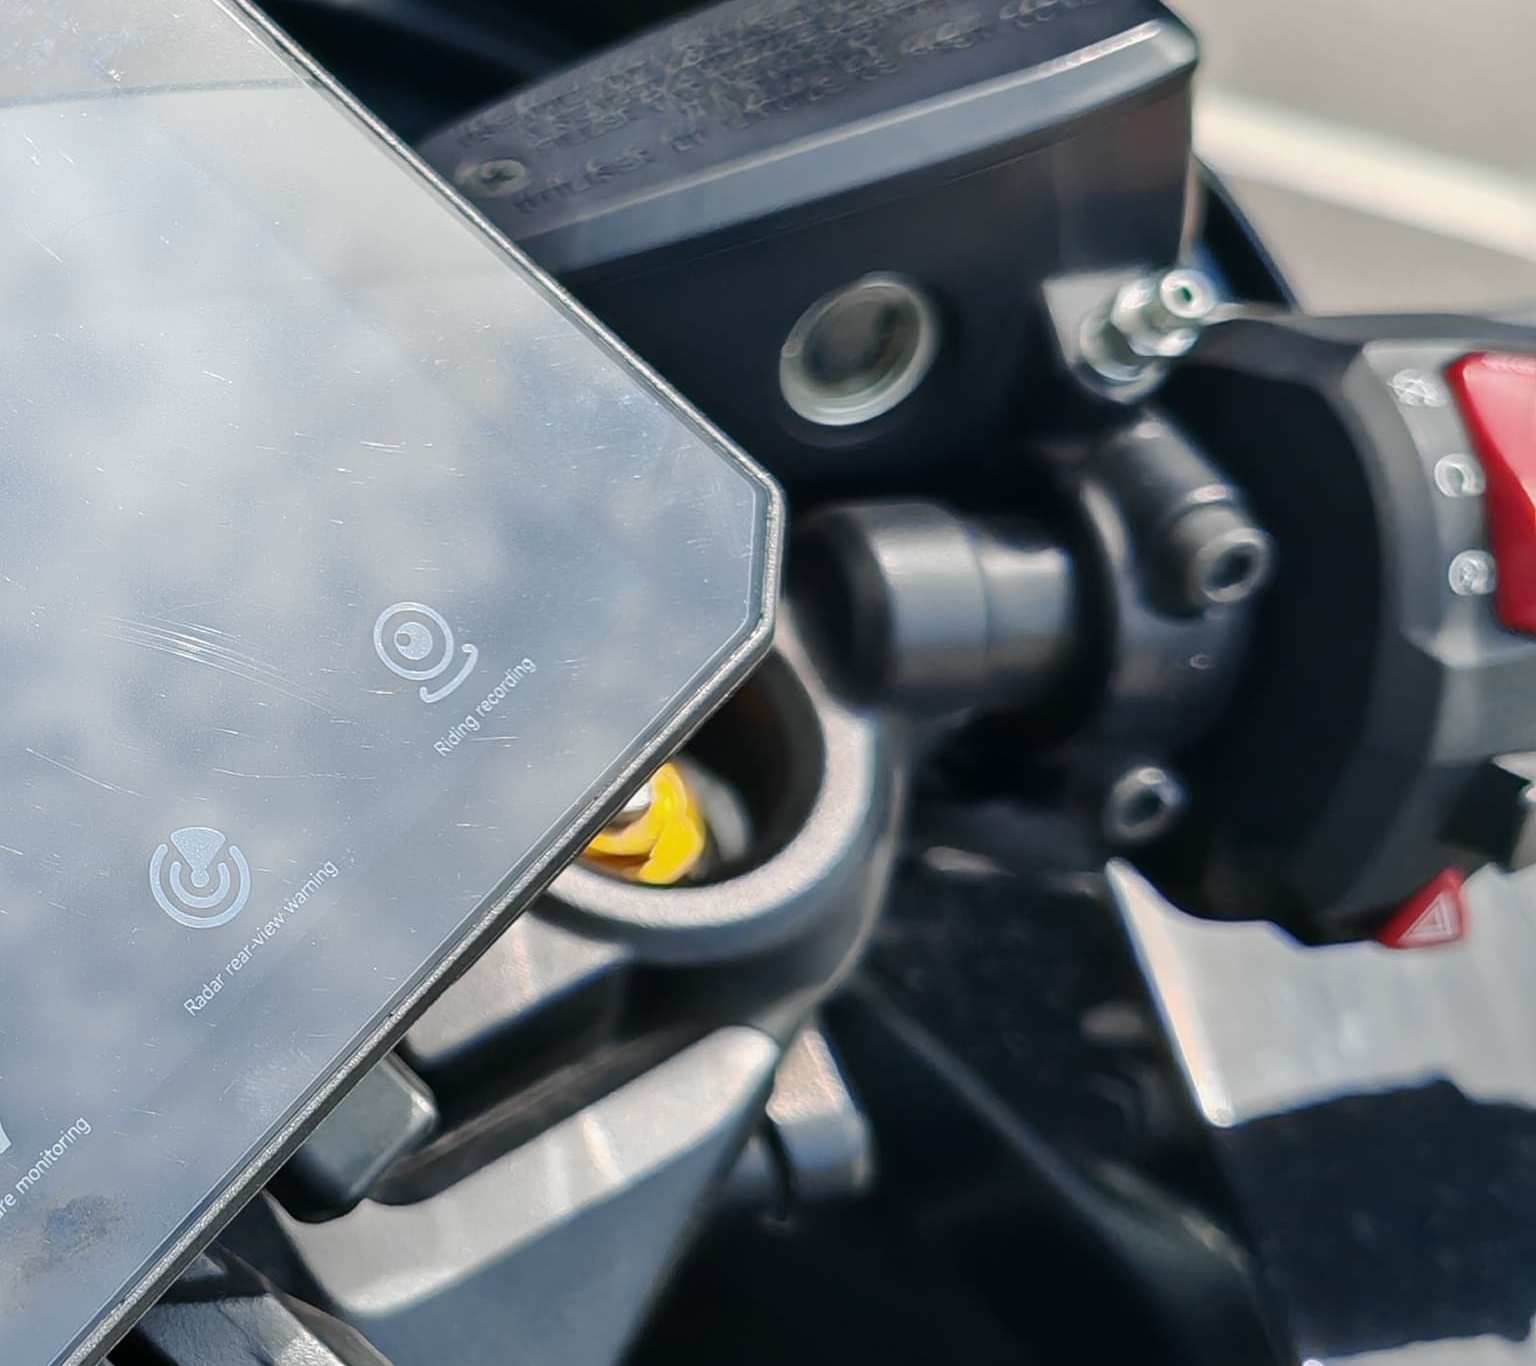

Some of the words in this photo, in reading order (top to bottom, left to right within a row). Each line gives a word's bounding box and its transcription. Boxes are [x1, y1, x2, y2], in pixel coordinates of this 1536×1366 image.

[433, 715, 480, 757] Riding
[475, 657, 536, 717] recording
[183, 973, 225, 1017] Radar
[225, 912, 285, 975] rear-view
[284, 860, 339, 914] warning
[15, 1117, 92, 1195] monitoring
